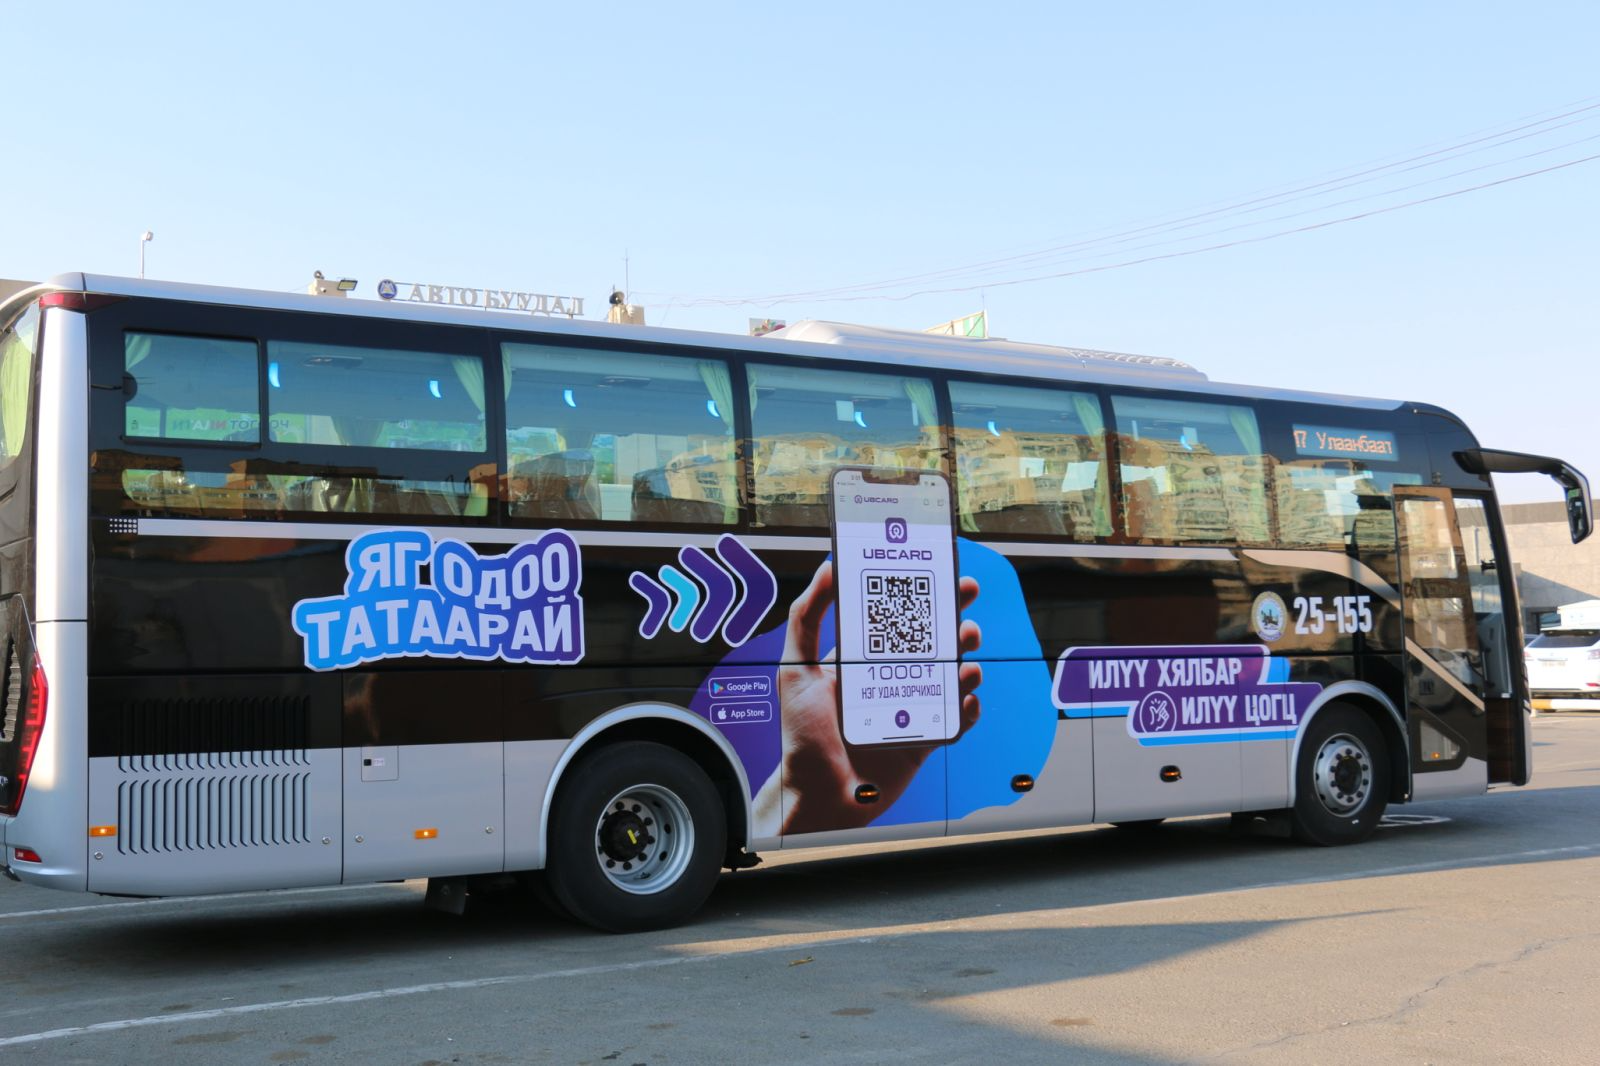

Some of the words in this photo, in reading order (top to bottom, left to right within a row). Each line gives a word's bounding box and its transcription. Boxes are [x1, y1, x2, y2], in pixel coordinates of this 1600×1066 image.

[407, 283, 478, 307] АВТО
[484, 288, 584, 318] БУУДАЛ
[863, 496, 899, 504] UBCARD
[863, 548, 932, 560] UBCARD
[358, 542, 421, 592] ЯГ
[442, 543, 570, 610] ОДОО
[306, 594, 572, 659] ТАТААРАЙ
[1293, 595, 1373, 634] 25-155
[726, 682, 752, 692] Google
[754, 682, 768, 692] Play
[1157, 657, 1242, 688] ХЯЛБАР
[861, 687, 876, 699] НЭГ
[878, 686, 900, 699] УДАА
[901, 684, 942, 698] ЗОРЧИХОД
[731, 709, 745, 719] App
[746, 708, 765, 717] Store
[1245, 693, 1297, 726] ЦОГЦ
